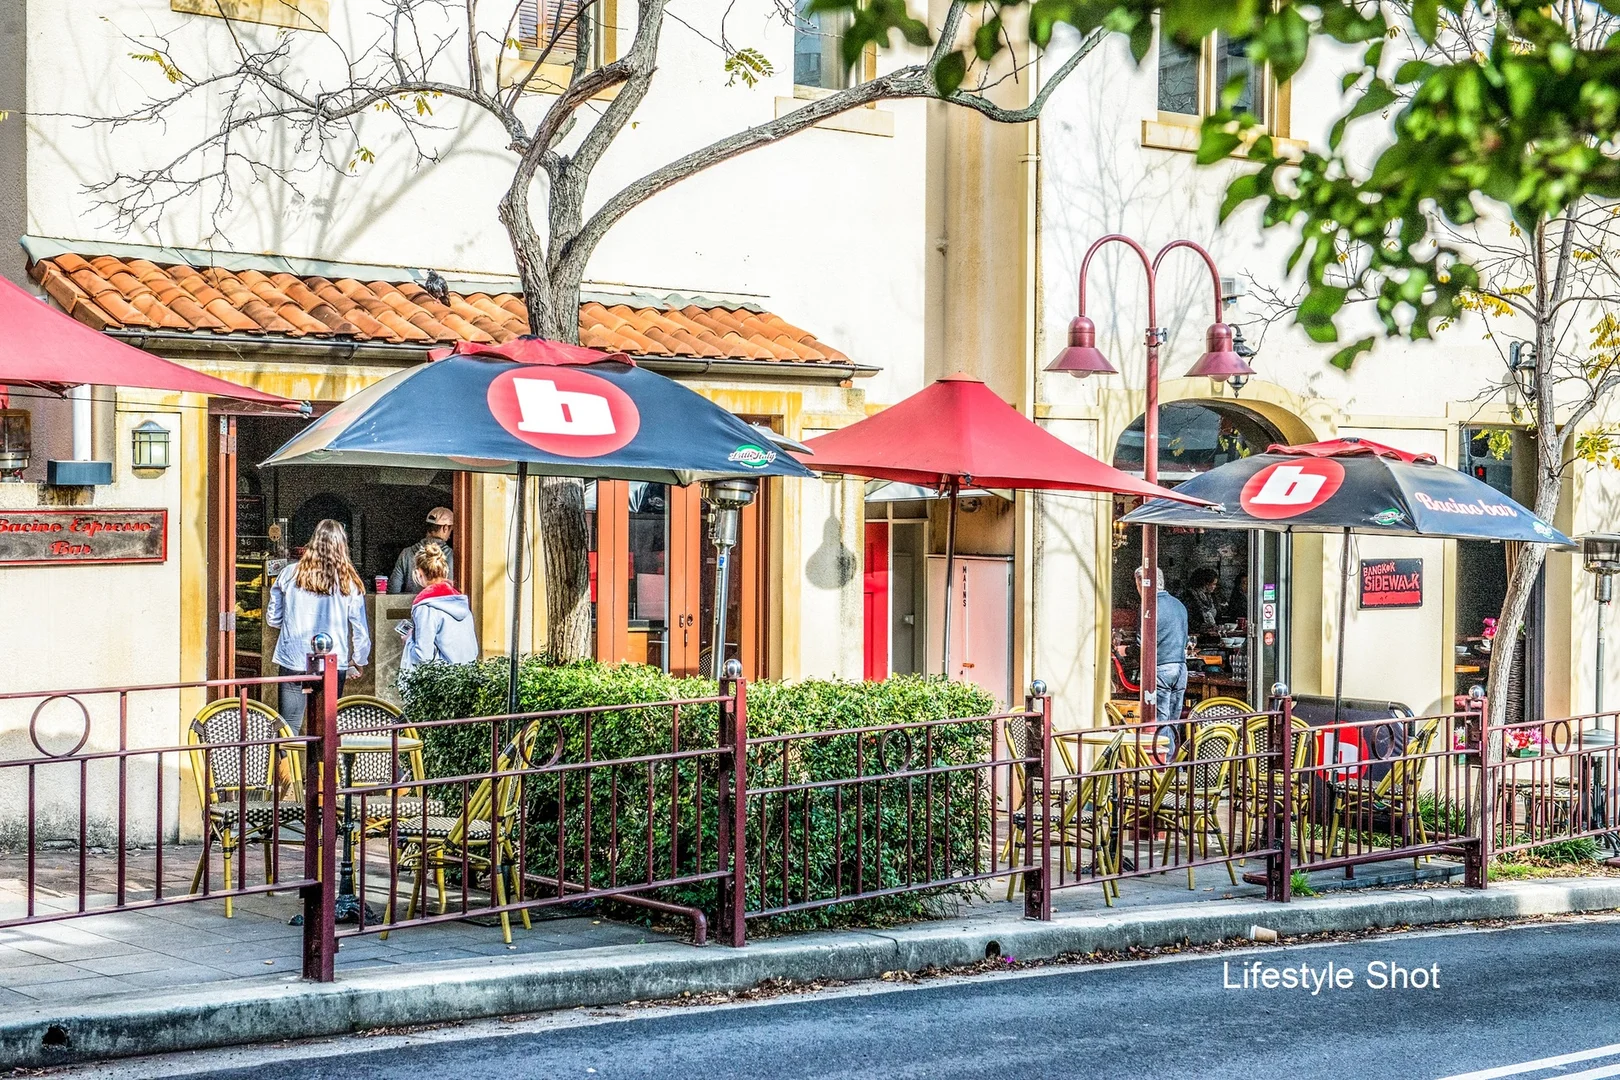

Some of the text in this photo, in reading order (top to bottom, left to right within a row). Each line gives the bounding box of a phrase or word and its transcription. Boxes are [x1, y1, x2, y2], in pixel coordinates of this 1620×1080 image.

[513, 377, 617, 436] b
[1249, 465, 1328, 505] b
[1414, 492, 1518, 518] Bacino bar
[69, 517, 152, 538] Espresso
[49, 540, 92, 555] Bar
